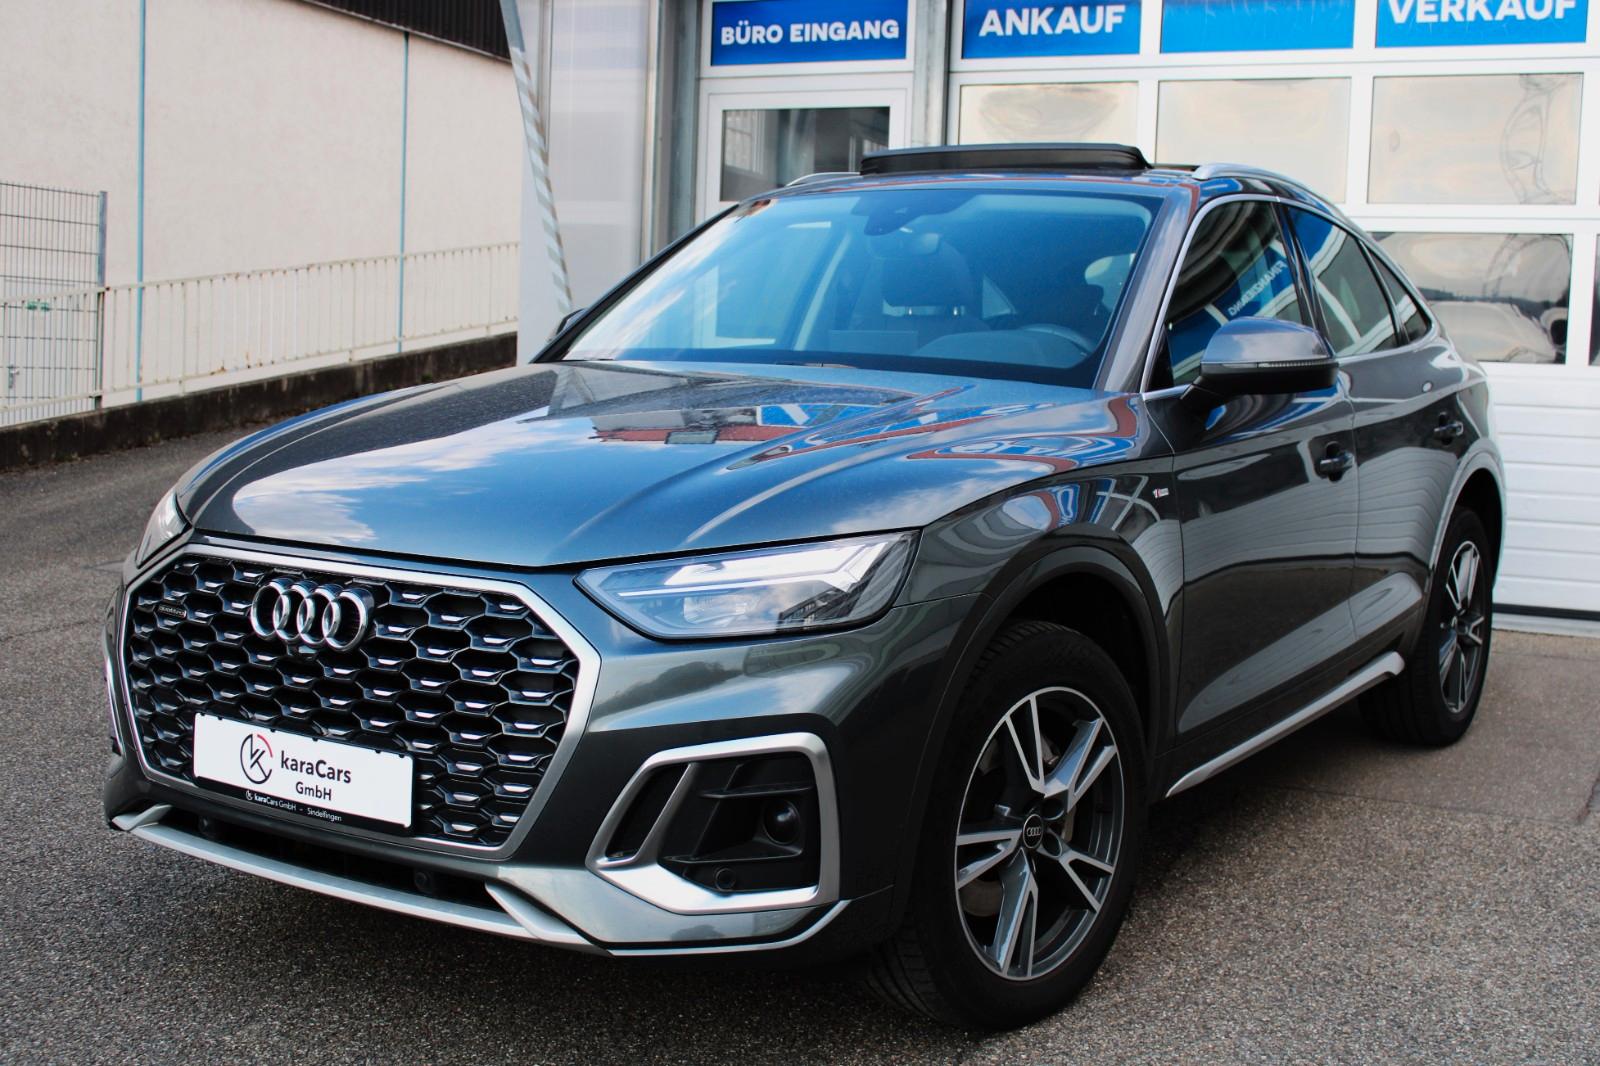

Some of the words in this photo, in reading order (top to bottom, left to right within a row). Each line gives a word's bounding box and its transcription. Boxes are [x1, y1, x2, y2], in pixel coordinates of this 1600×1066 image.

[978, 5, 1126, 37] ANKAUF
[1387, 0, 1576, 24] VERKAUF
[720, 20, 783, 45] BÜRO
[790, 19, 900, 42] EINGANG
[281, 750, 351, 783] karaCars
[295, 781, 332, 801] GmbH
[254, 793, 278, 806] karaCars
[279, 800, 297, 811] GmbH
[307, 808, 342, 821] Sindelfingen
